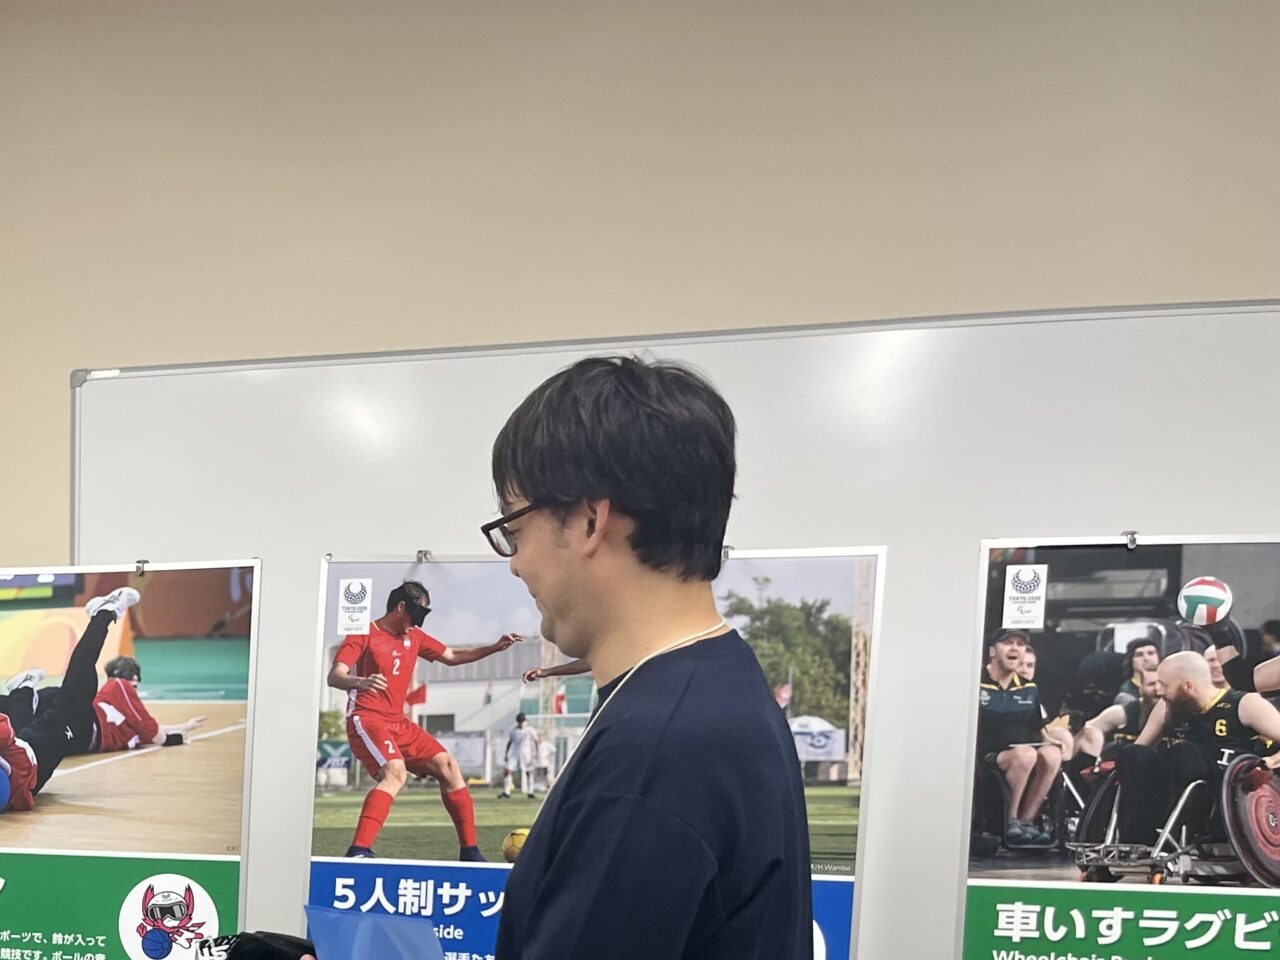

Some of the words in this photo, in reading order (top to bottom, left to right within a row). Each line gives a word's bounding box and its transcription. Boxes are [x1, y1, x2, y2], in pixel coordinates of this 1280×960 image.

[392, 658, 401, 675] 2
[1215, 718, 1227, 737] 6
[384, 740, 395, 754] 2
[333, 877, 505, 917] 5人制サッ
[993, 901, 1279, 950] 車いすラグビ
